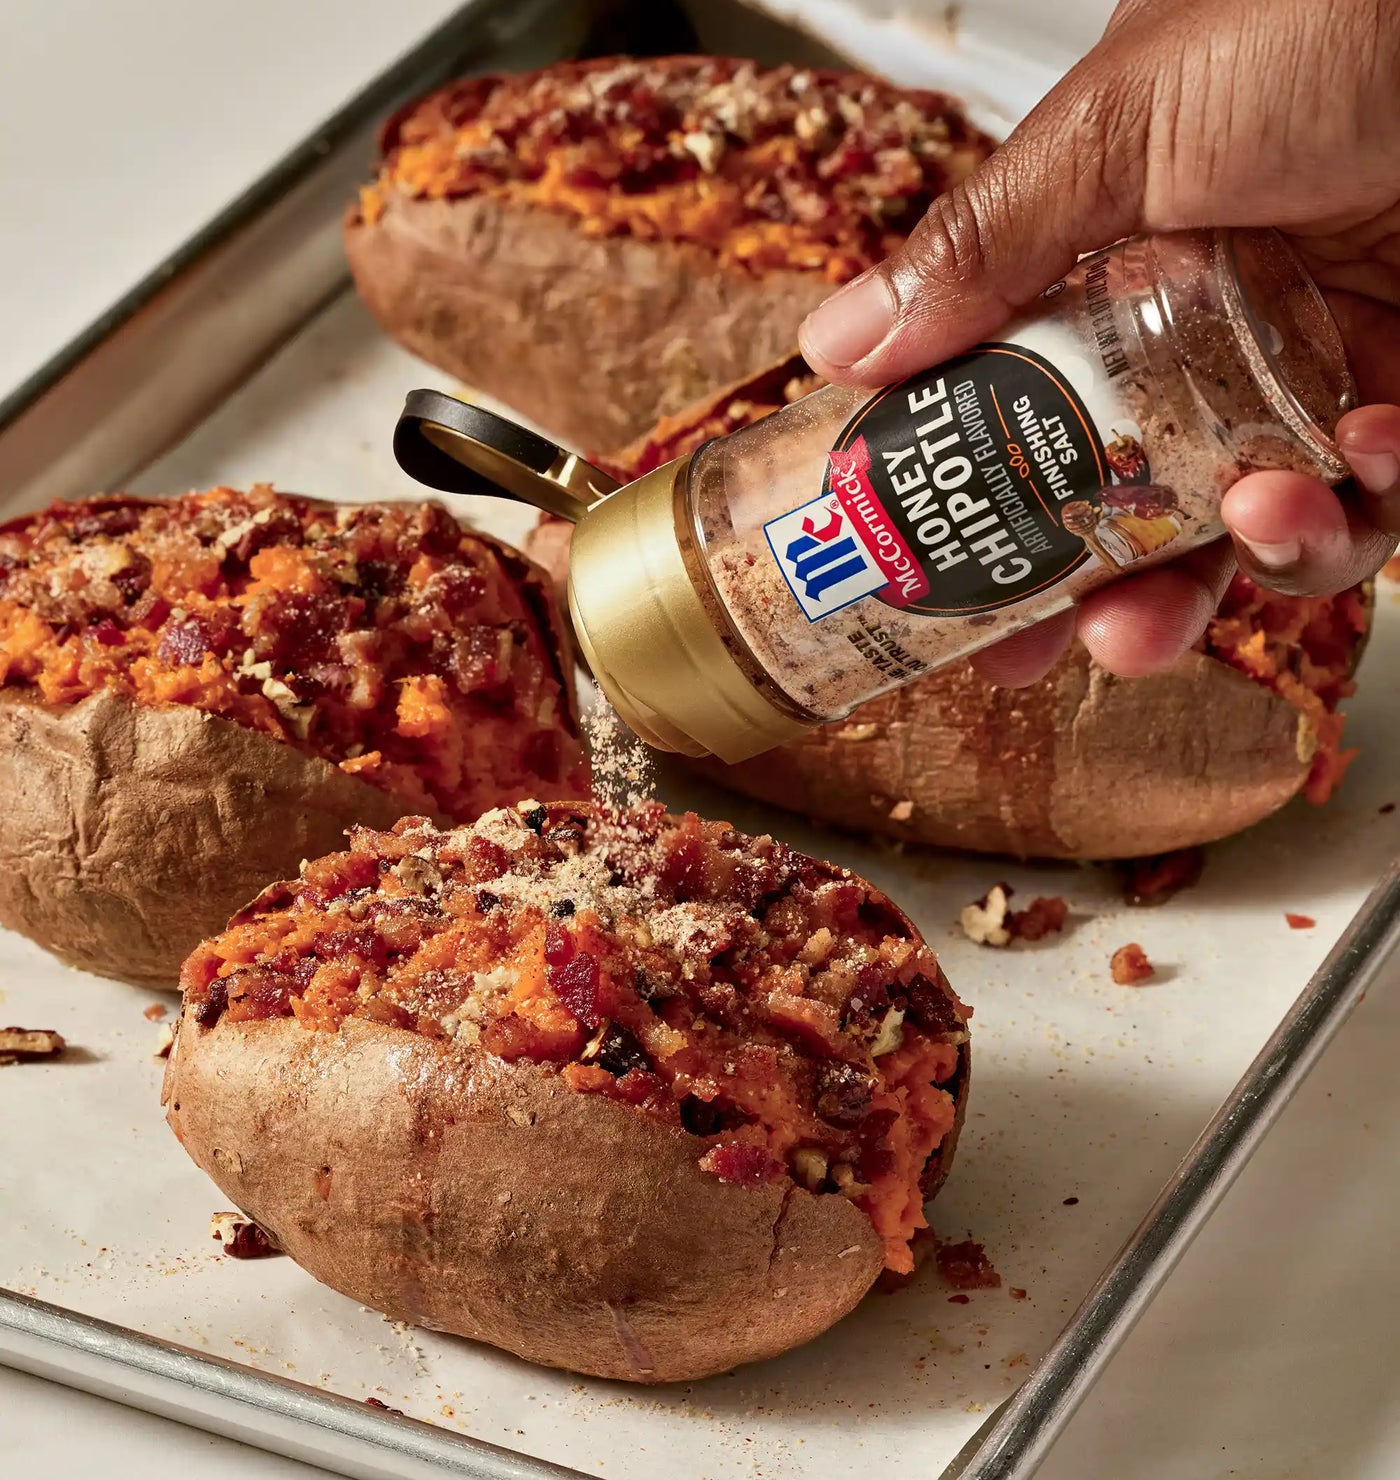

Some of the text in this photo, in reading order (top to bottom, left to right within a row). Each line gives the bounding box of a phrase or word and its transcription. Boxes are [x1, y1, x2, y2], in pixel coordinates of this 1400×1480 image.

[1101, 347, 1131, 378] NET
[907, 377, 1033, 585] CHIPOTLE
[953, 380, 1053, 554] ARTIFICIALLY FLAVORED
[1012, 395, 1074, 501] FINISHING
[1042, 415, 1078, 465] SALT
[882, 446, 969, 572] HONEY
[847, 630, 893, 672] TASTE
